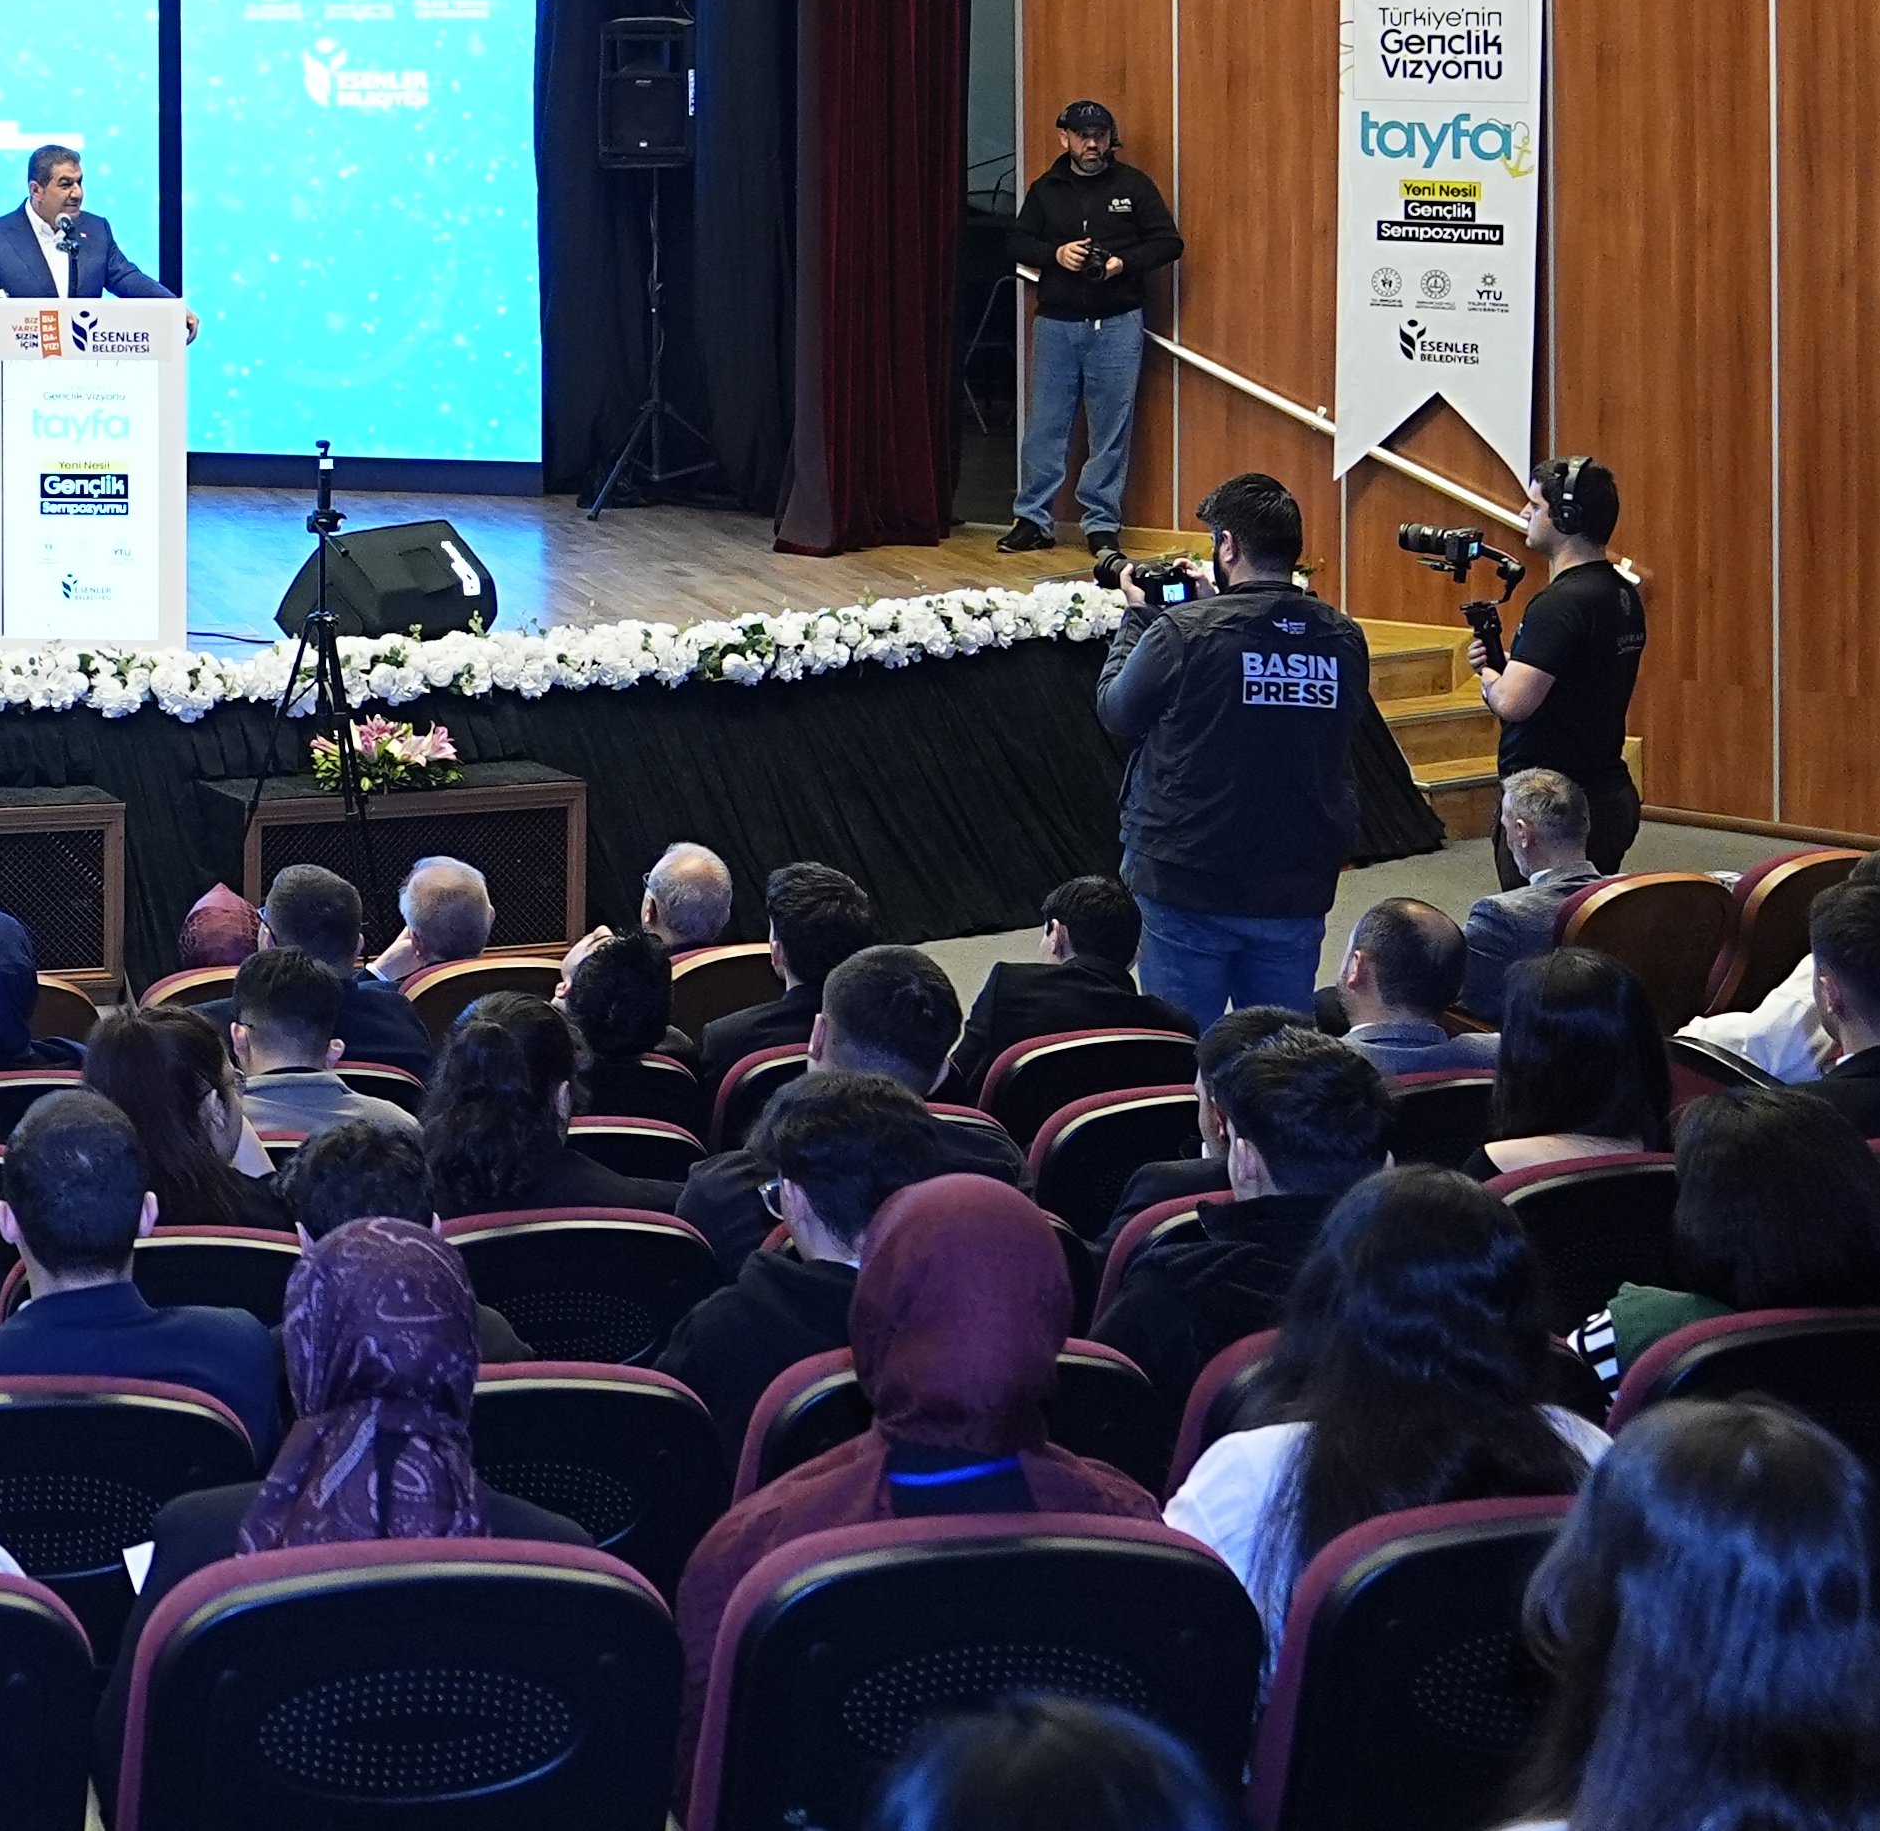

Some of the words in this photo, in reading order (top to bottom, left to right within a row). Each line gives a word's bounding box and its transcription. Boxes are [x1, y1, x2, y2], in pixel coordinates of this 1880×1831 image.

[1379, 7, 1502, 29] Türkiye'nin
[1381, 54, 1502, 84] Vizyonu
[1361, 111, 1512, 168] tayfa
[1404, 183, 1435, 196] Yeni
[1440, 184, 1476, 197] Nesil
[1407, 202, 1472, 221] Gençlik
[1380, 223, 1501, 242] Sempozyumu
[1477, 290, 1502, 300] YTU
[93, 332, 149, 342] ESENLER
[1421, 340, 1479, 354] ESENLER
[32, 408, 130, 444] tayfa
[43, 475, 125, 498] Gençlik
[41, 501, 128, 515] Sempozyumu
[1243, 652, 1338, 680] BASIN
[1245, 680, 1335, 706] PRESS
